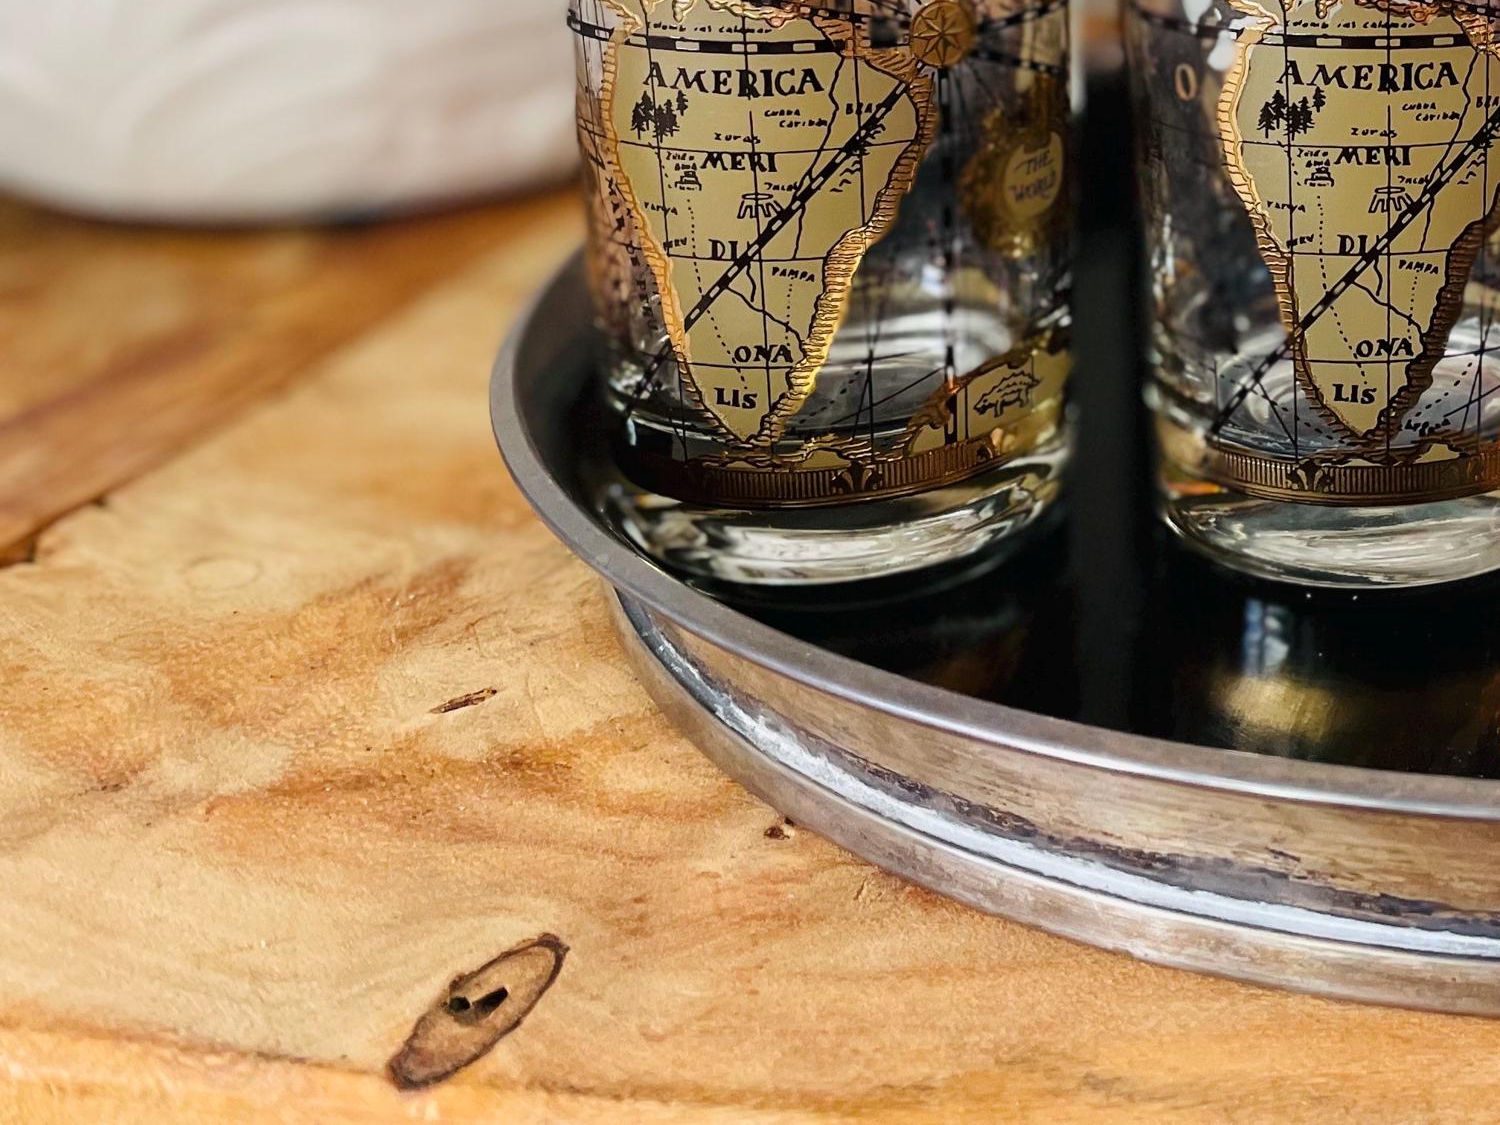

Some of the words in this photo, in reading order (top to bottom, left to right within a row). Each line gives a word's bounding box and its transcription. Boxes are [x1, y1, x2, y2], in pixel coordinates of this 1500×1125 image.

[643, 61, 825, 99] AMERICA
[1276, 59, 1459, 93] AMERICA
[700, 151, 778, 173] MERI
[1334, 146, 1411, 166] MERI
[734, 344, 794, 363] ONA
[1356, 337, 1414, 358] ONA
[714, 387, 758, 409] LIS
[1332, 383, 1377, 404] LIS
